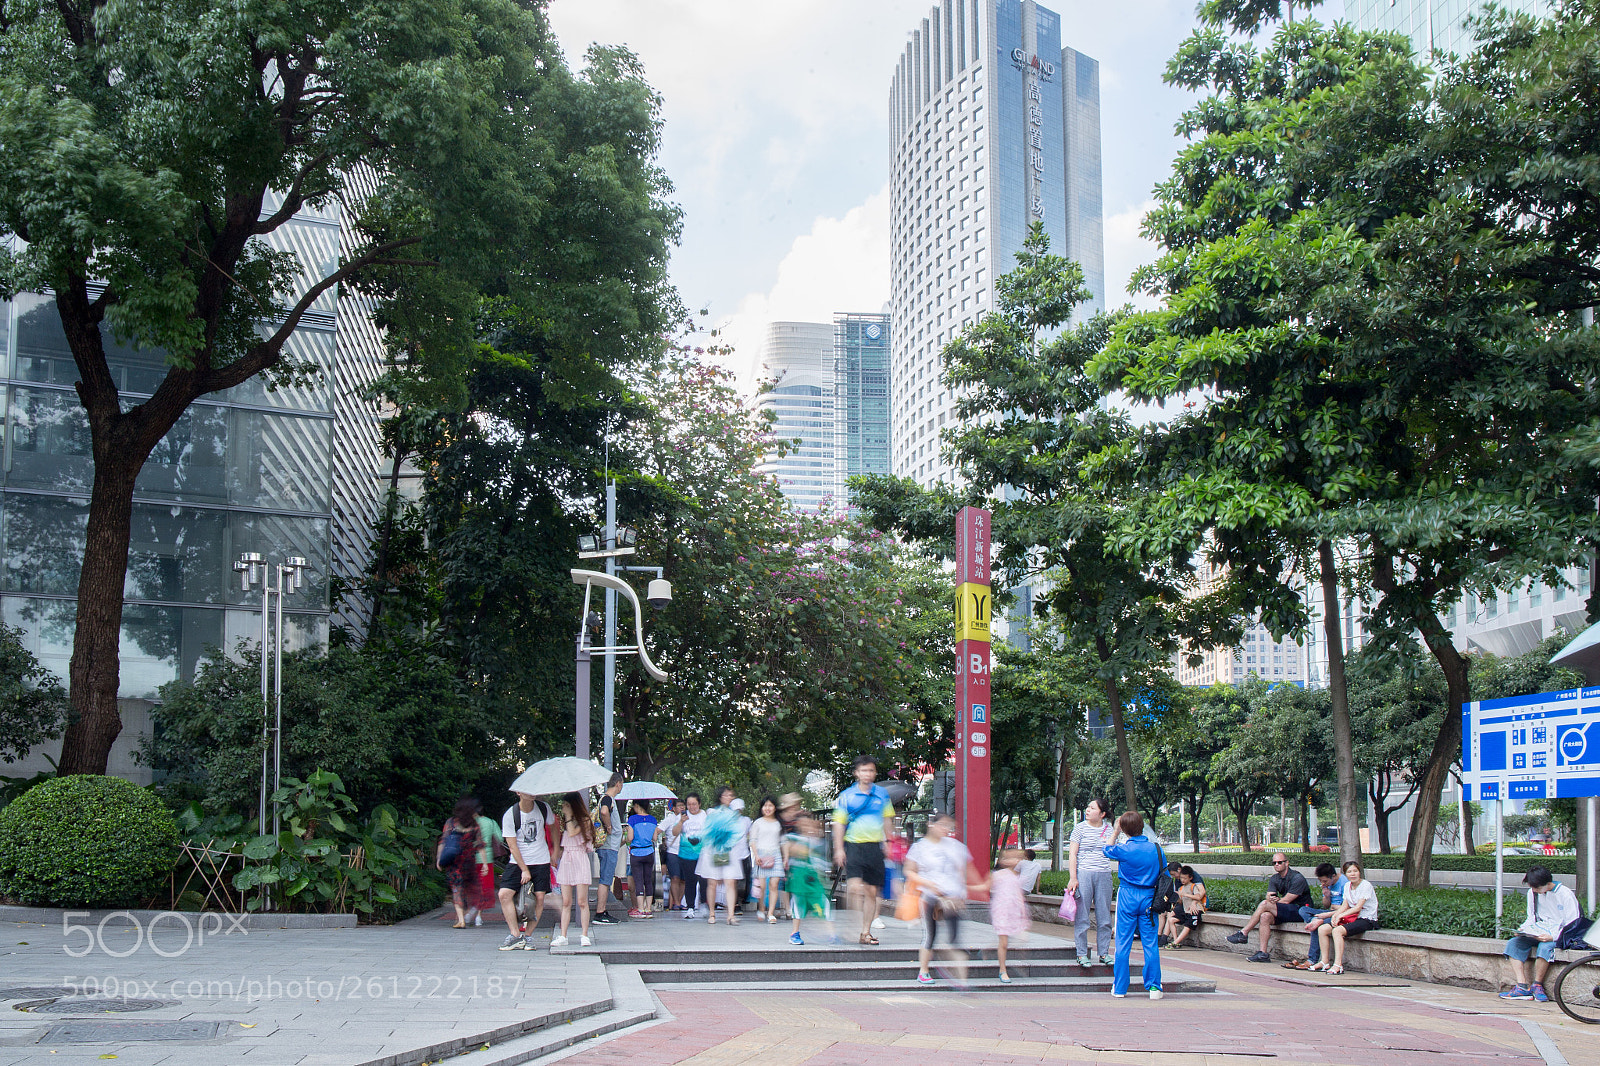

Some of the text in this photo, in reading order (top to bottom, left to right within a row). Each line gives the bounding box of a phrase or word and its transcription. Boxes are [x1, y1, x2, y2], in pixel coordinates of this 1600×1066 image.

[1028, 82, 1045, 218] 高德置地广场
[974, 514, 984, 579] 珠江新城站
[970, 653, 988, 675] B1
[973, 677, 986, 686] 入口
